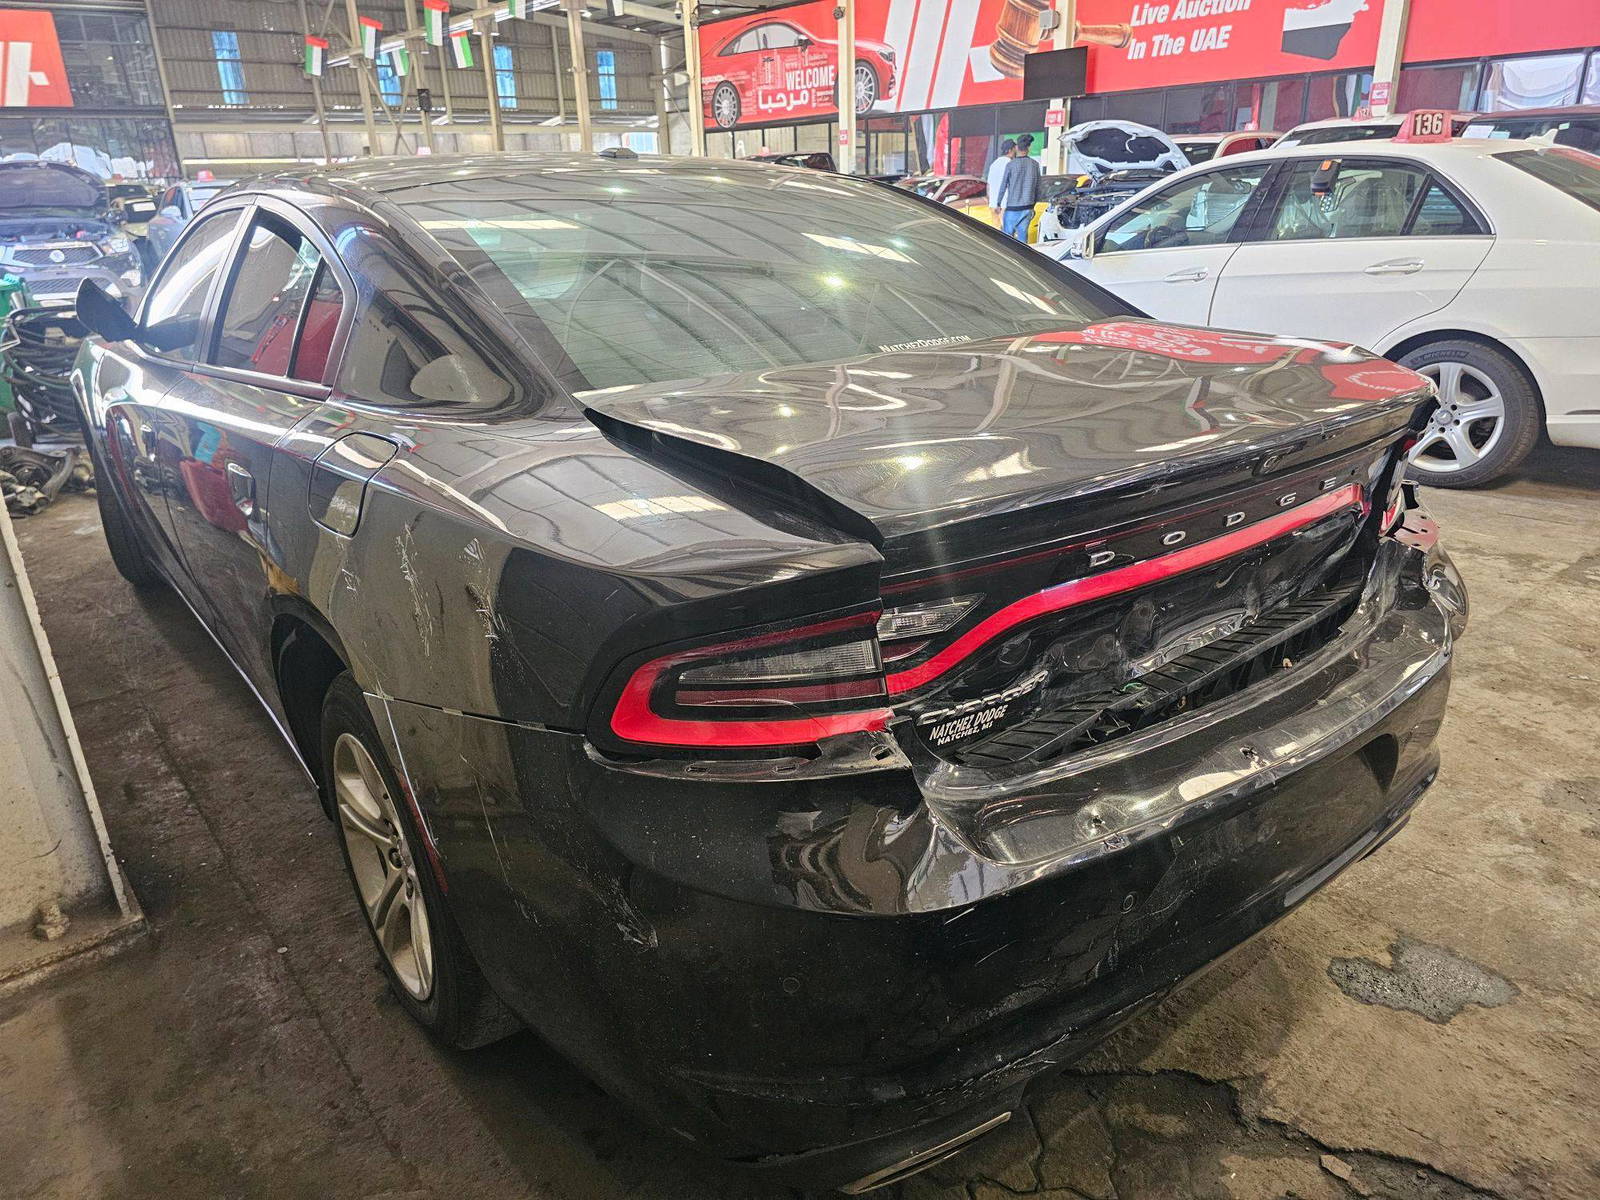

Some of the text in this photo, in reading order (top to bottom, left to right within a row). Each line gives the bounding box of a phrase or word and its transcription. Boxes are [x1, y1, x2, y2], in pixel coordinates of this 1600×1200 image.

[1130, 0, 1251, 27] Live Auction
[1127, 25, 1233, 60] In The UAE
[785, 64, 835, 91] WELCOME
[757, 89, 809, 113] مرحبا
[1415, 112, 1443, 136] 136
[1088, 477, 1337, 567] DODGE
[929, 704, 1009, 741] NATCHEZ DODGE
[937, 721, 994, 746] NATCHEZ, MS
